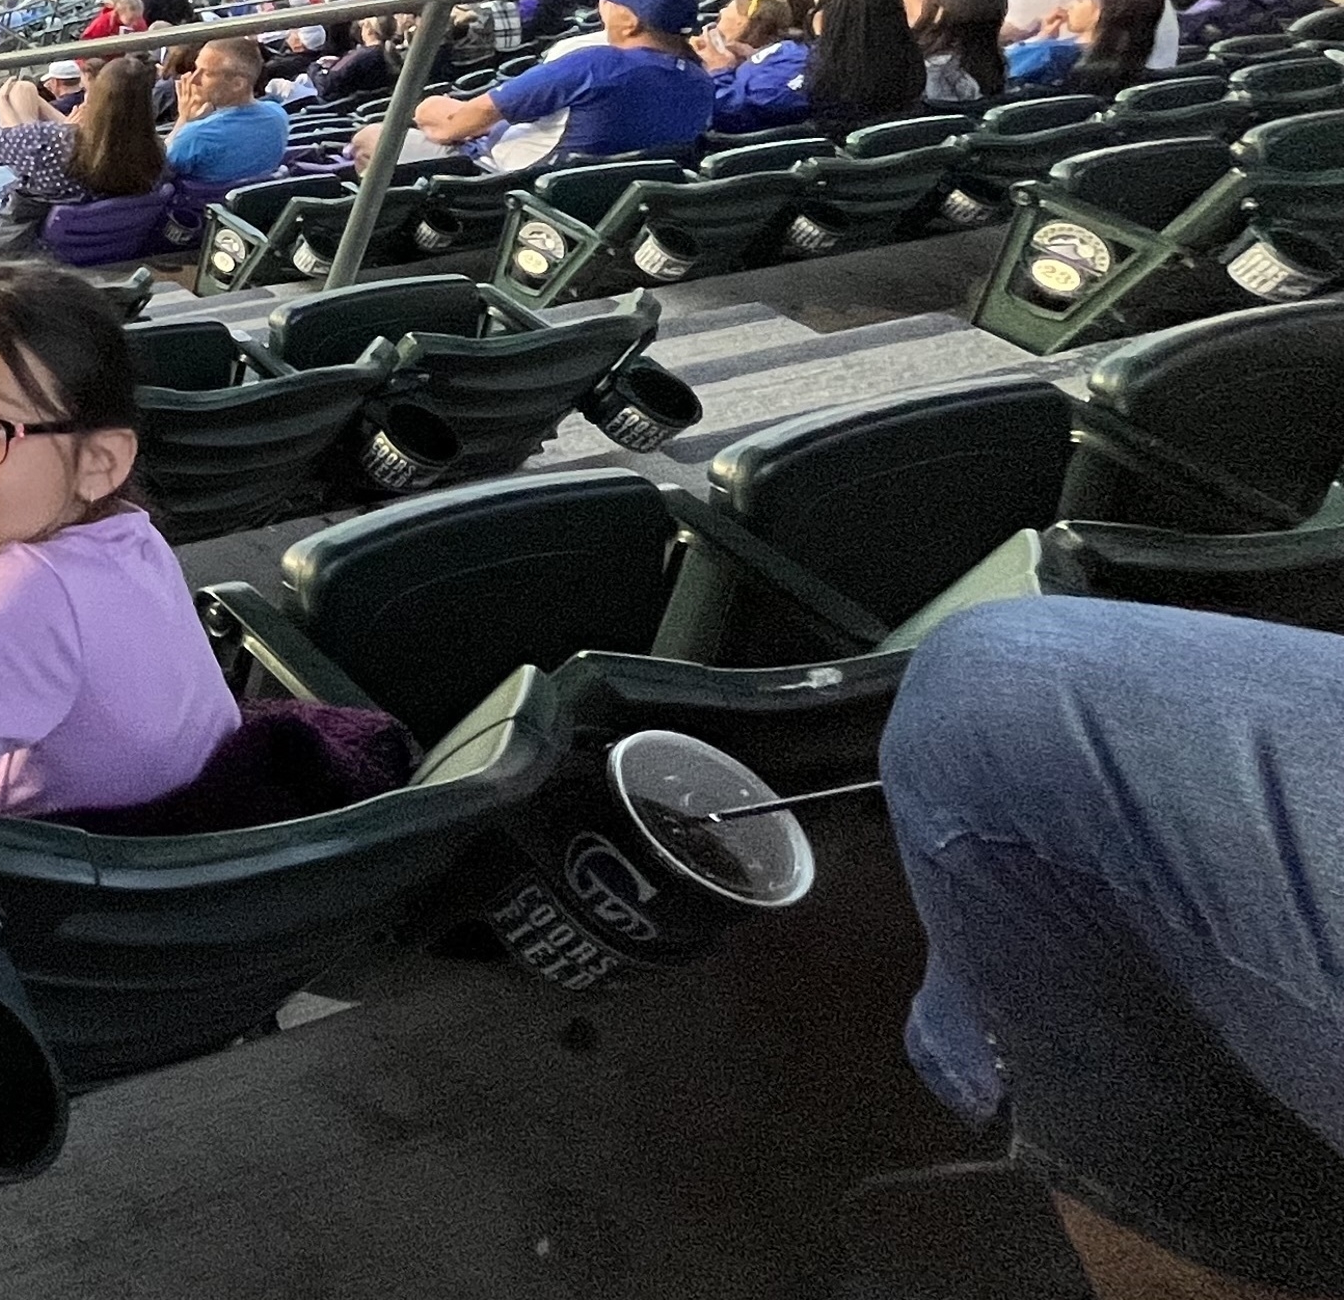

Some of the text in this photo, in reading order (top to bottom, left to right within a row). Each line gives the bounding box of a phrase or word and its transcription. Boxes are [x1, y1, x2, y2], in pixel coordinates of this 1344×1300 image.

[372, 437, 416, 478] COORS
[492, 903, 596, 991] FIELD
[516, 884, 619, 975] COORS
